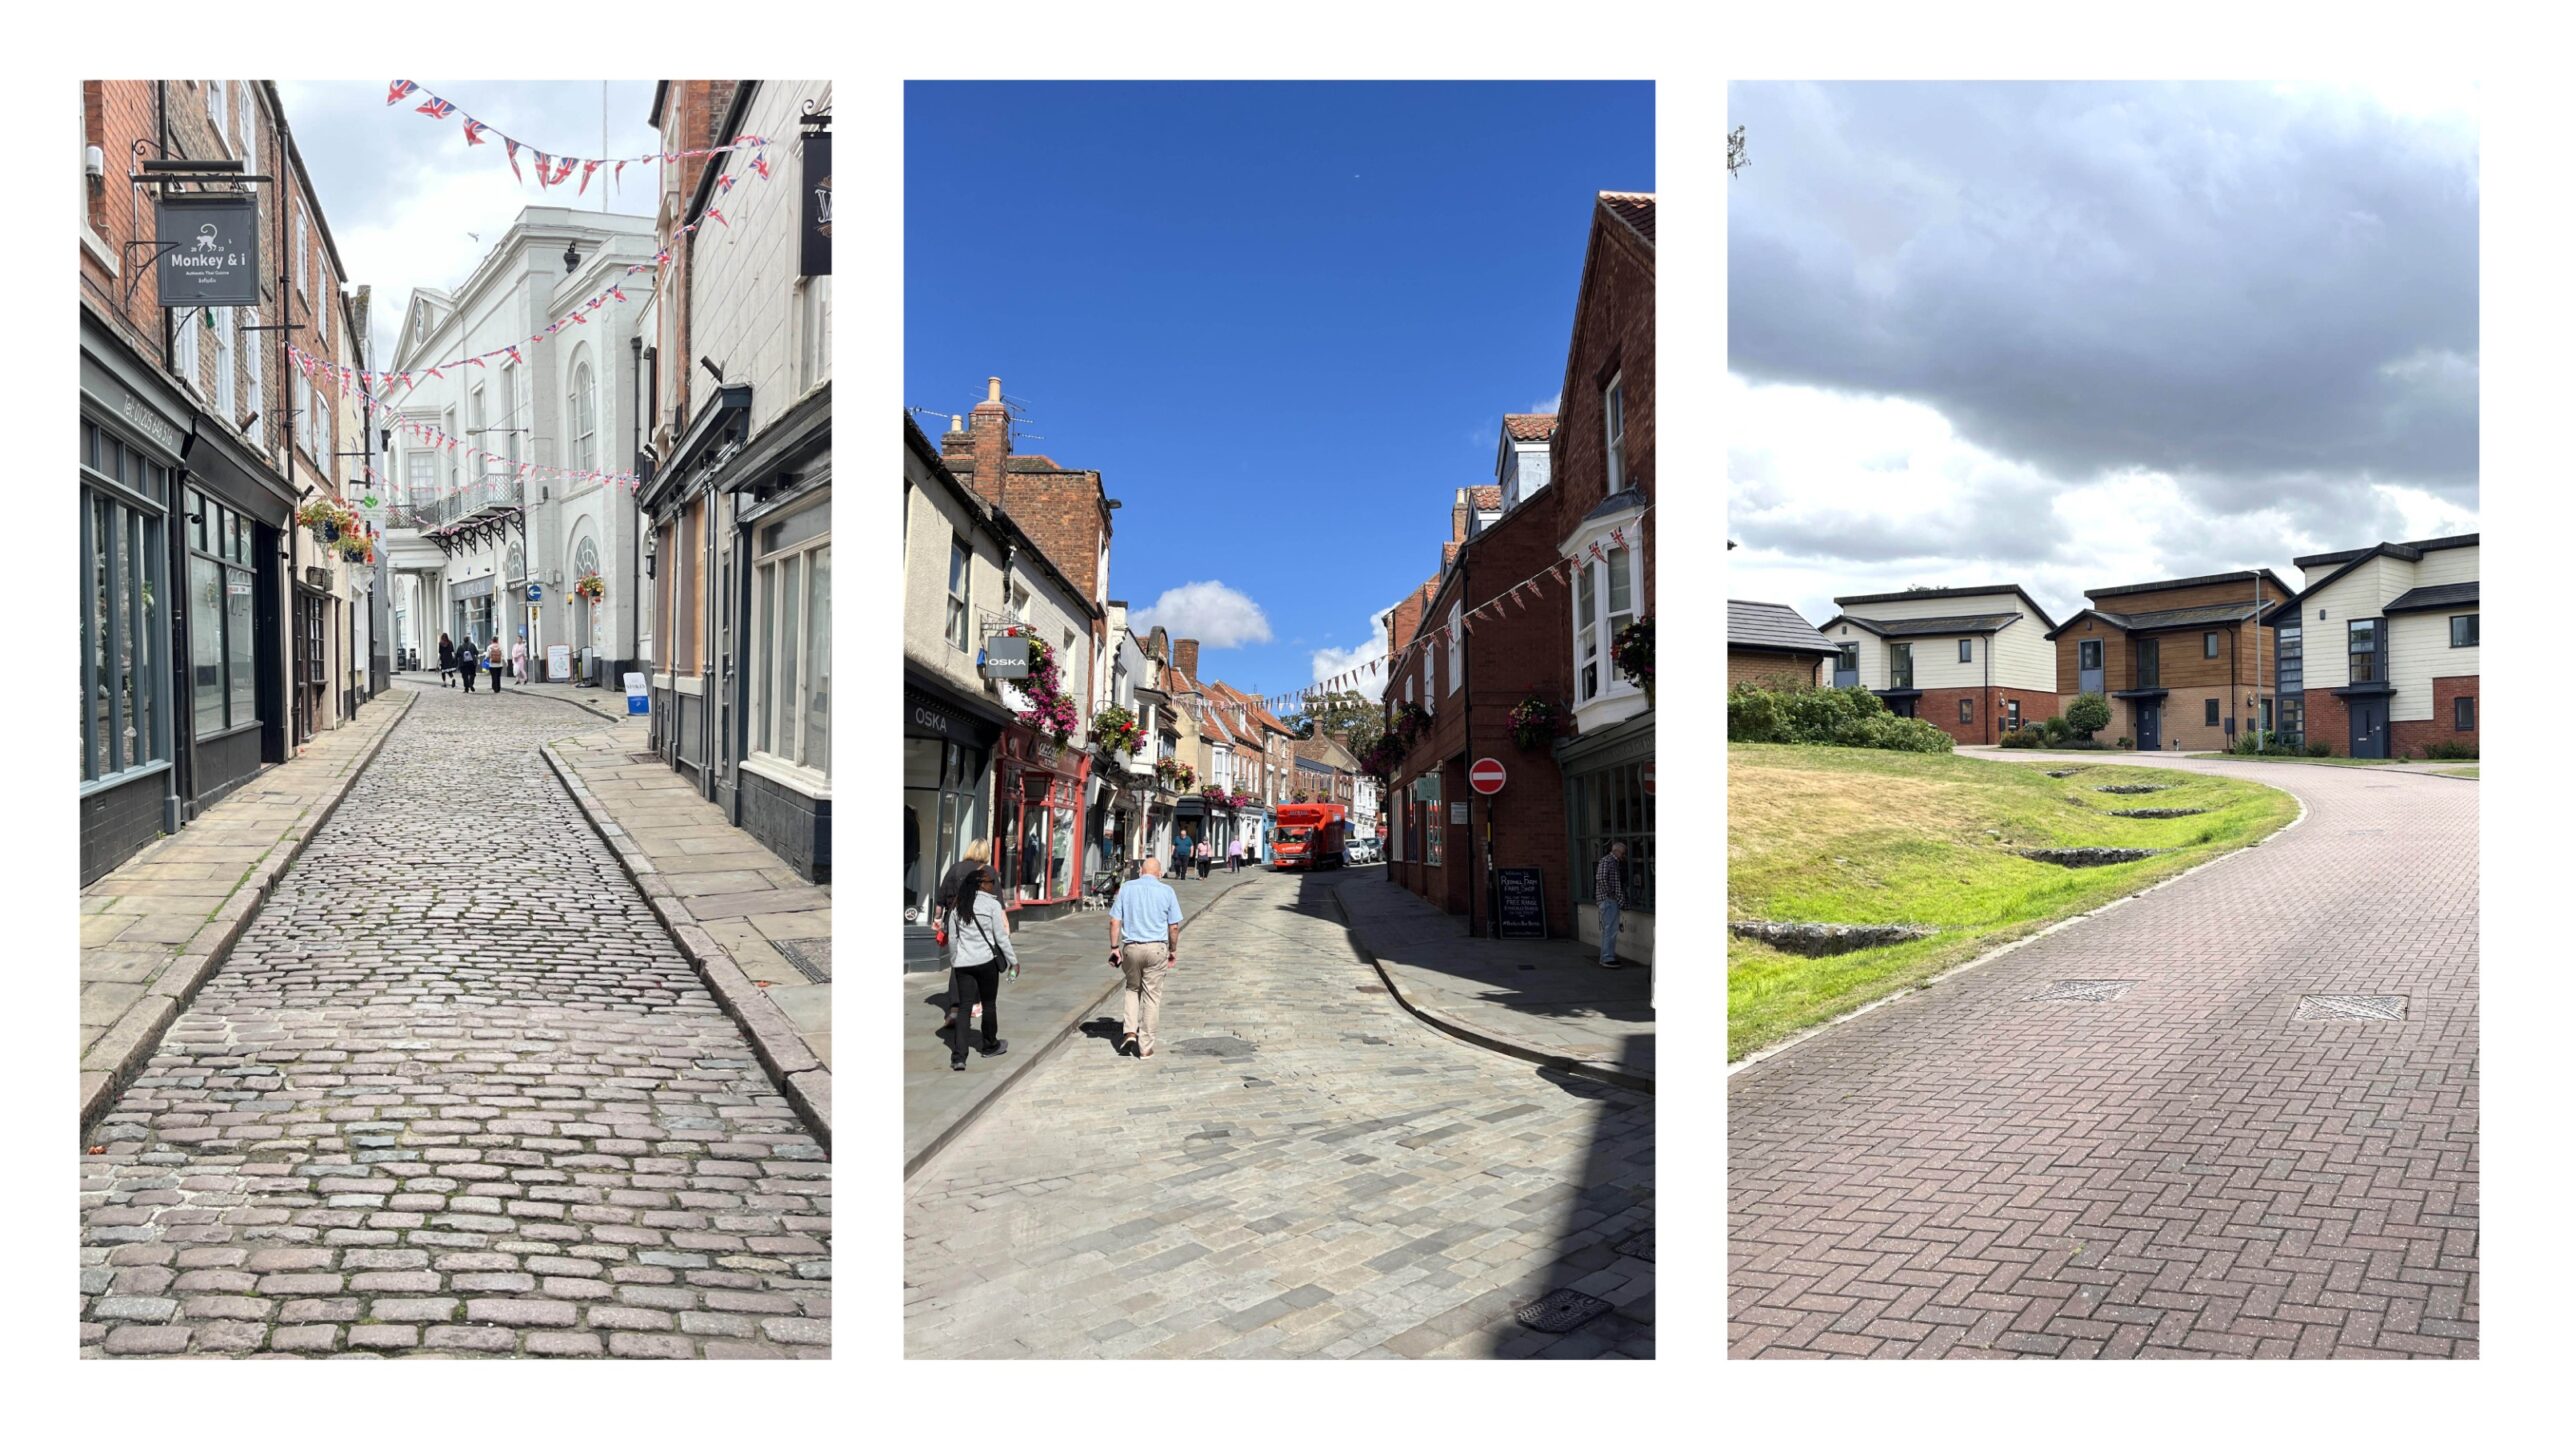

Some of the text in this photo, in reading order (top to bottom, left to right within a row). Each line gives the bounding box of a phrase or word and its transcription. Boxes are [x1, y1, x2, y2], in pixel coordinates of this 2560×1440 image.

[171, 253, 246, 269] Monkey & i
[988, 658, 1027, 667] OSKA
[915, 706, 948, 734] OSKA
